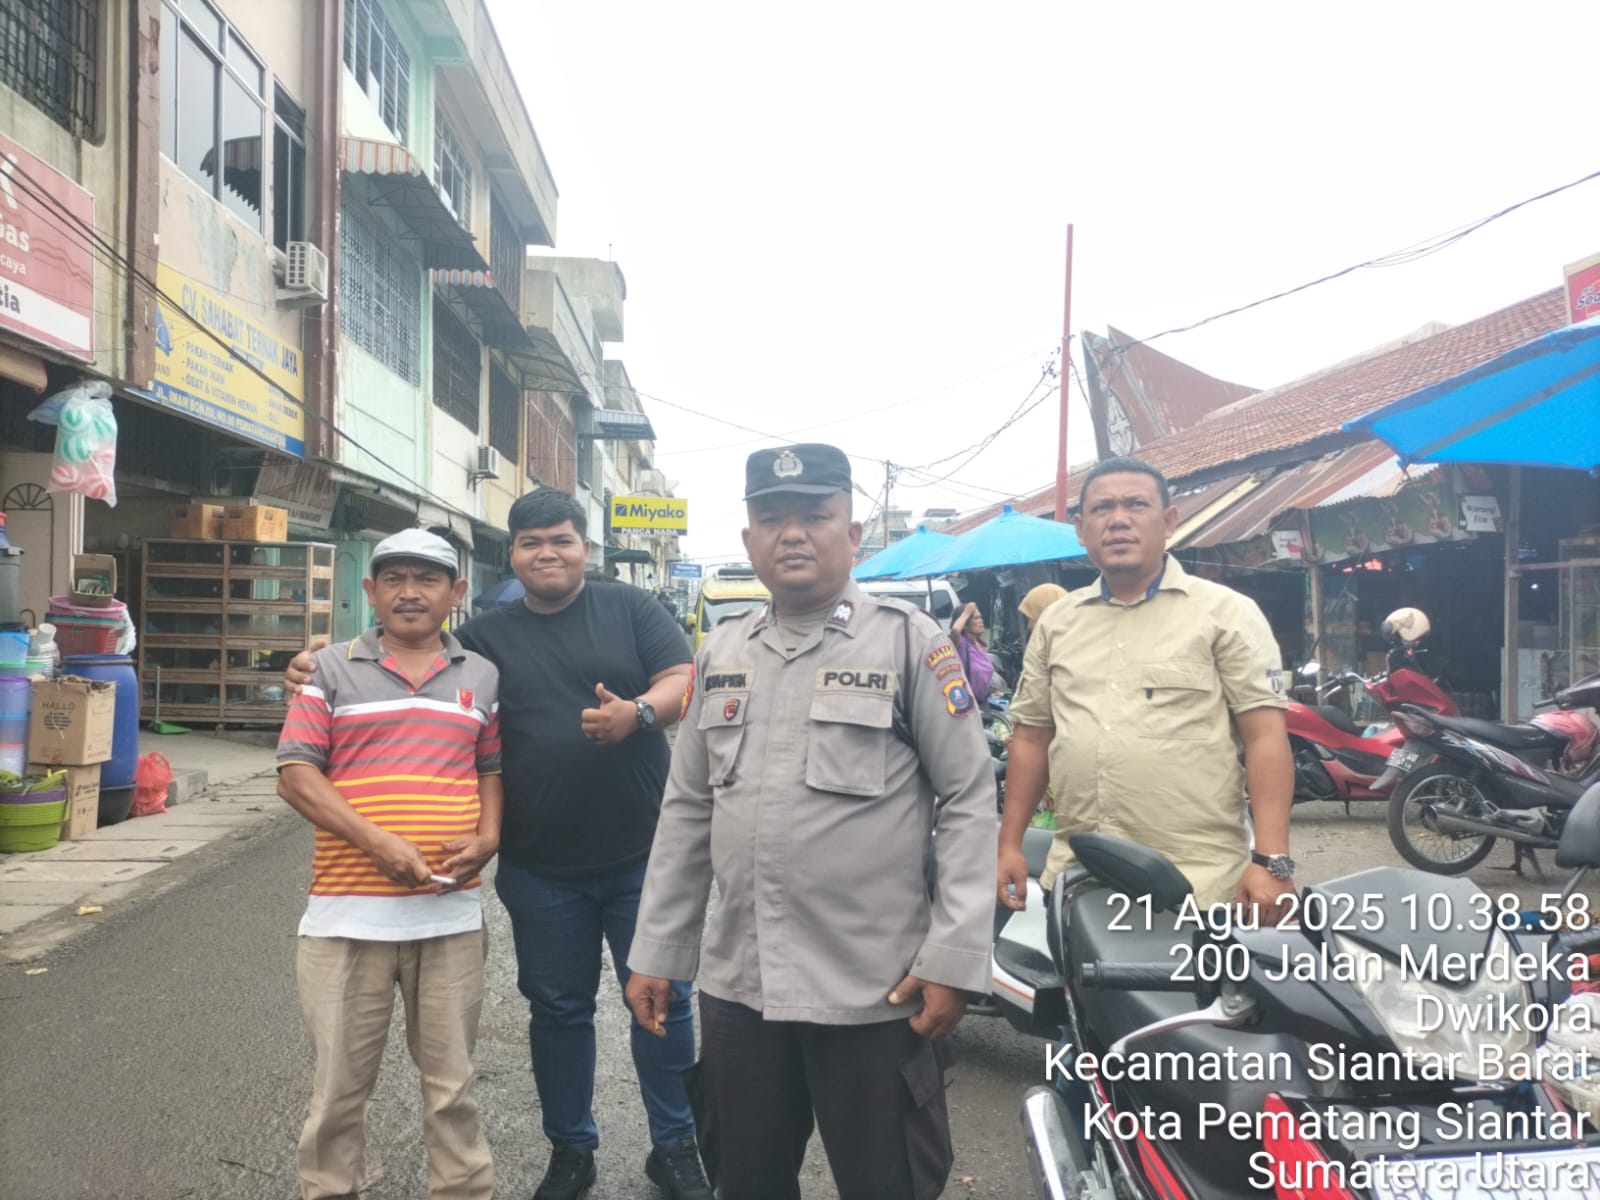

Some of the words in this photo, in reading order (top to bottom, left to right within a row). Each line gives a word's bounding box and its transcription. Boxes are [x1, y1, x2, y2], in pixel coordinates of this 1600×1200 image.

[201, 295, 243, 345] SAHABAT
[246, 322, 280, 366] TERNAK
[282, 345, 298, 377] JAYA
[629, 503, 685, 522] Miyako
[824, 671, 888, 690] POLRI
[42, 701, 75, 711] HALLO
